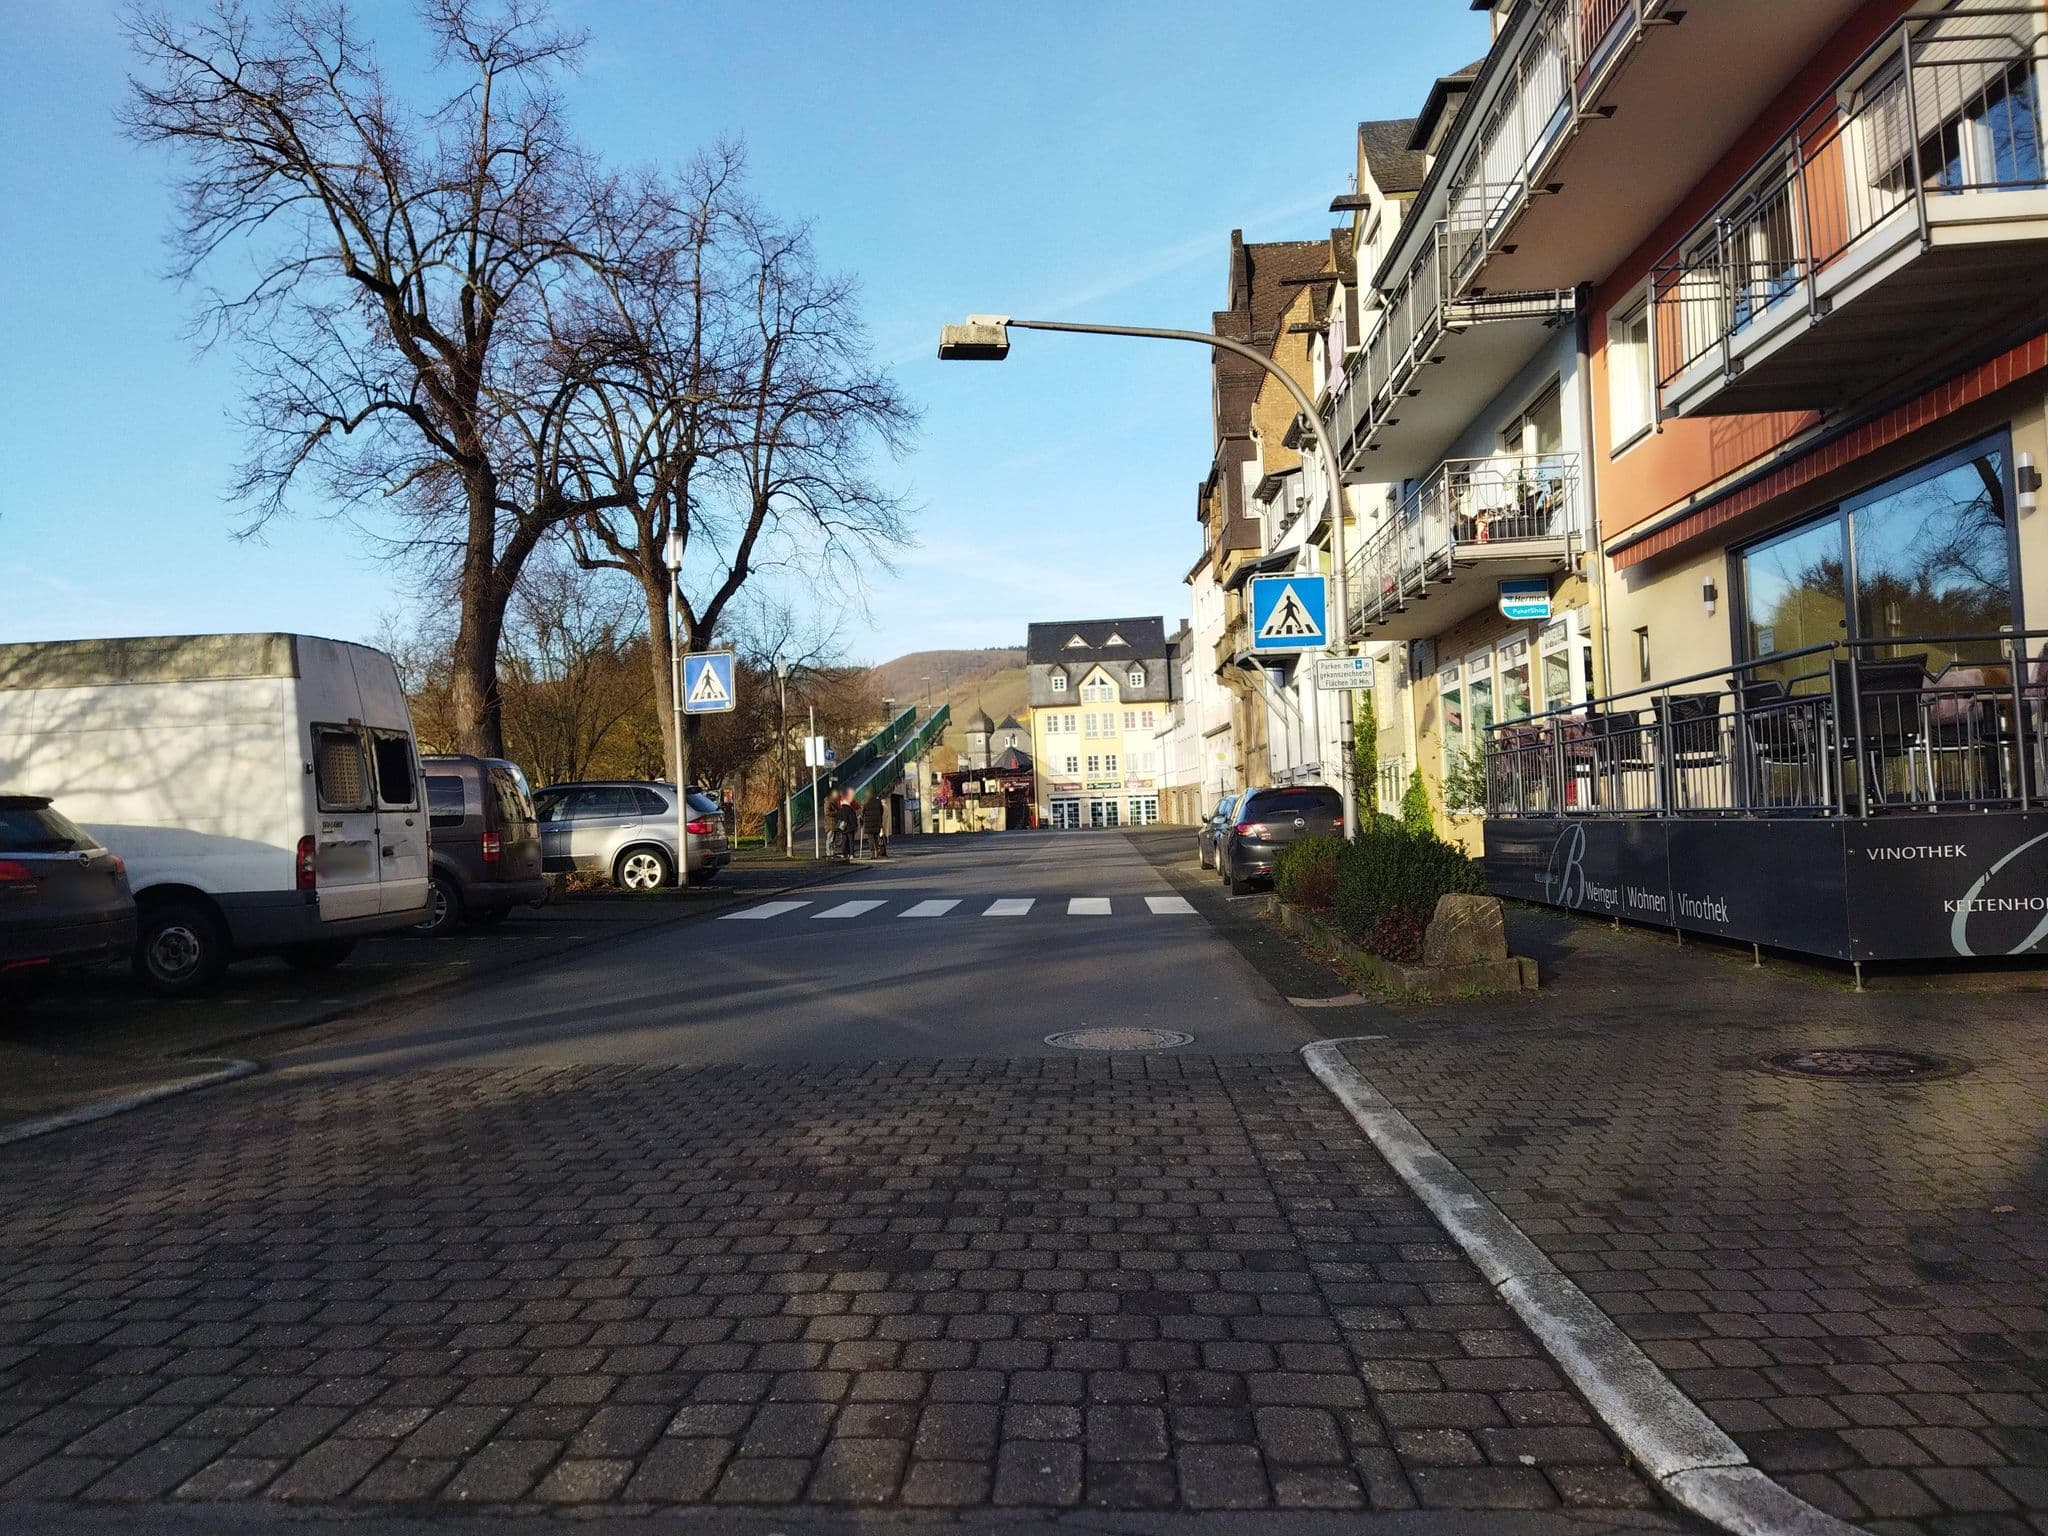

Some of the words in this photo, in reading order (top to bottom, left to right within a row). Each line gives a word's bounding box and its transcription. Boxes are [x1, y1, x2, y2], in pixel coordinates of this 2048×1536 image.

[1514, 594, 1546, 602] Hermes
[1866, 844, 1968, 860] VINOTHEK
[1585, 881, 1619, 909] Weingut
[1627, 886, 1667, 912] Wohnen
[1678, 893, 1729, 923] Vinothek
